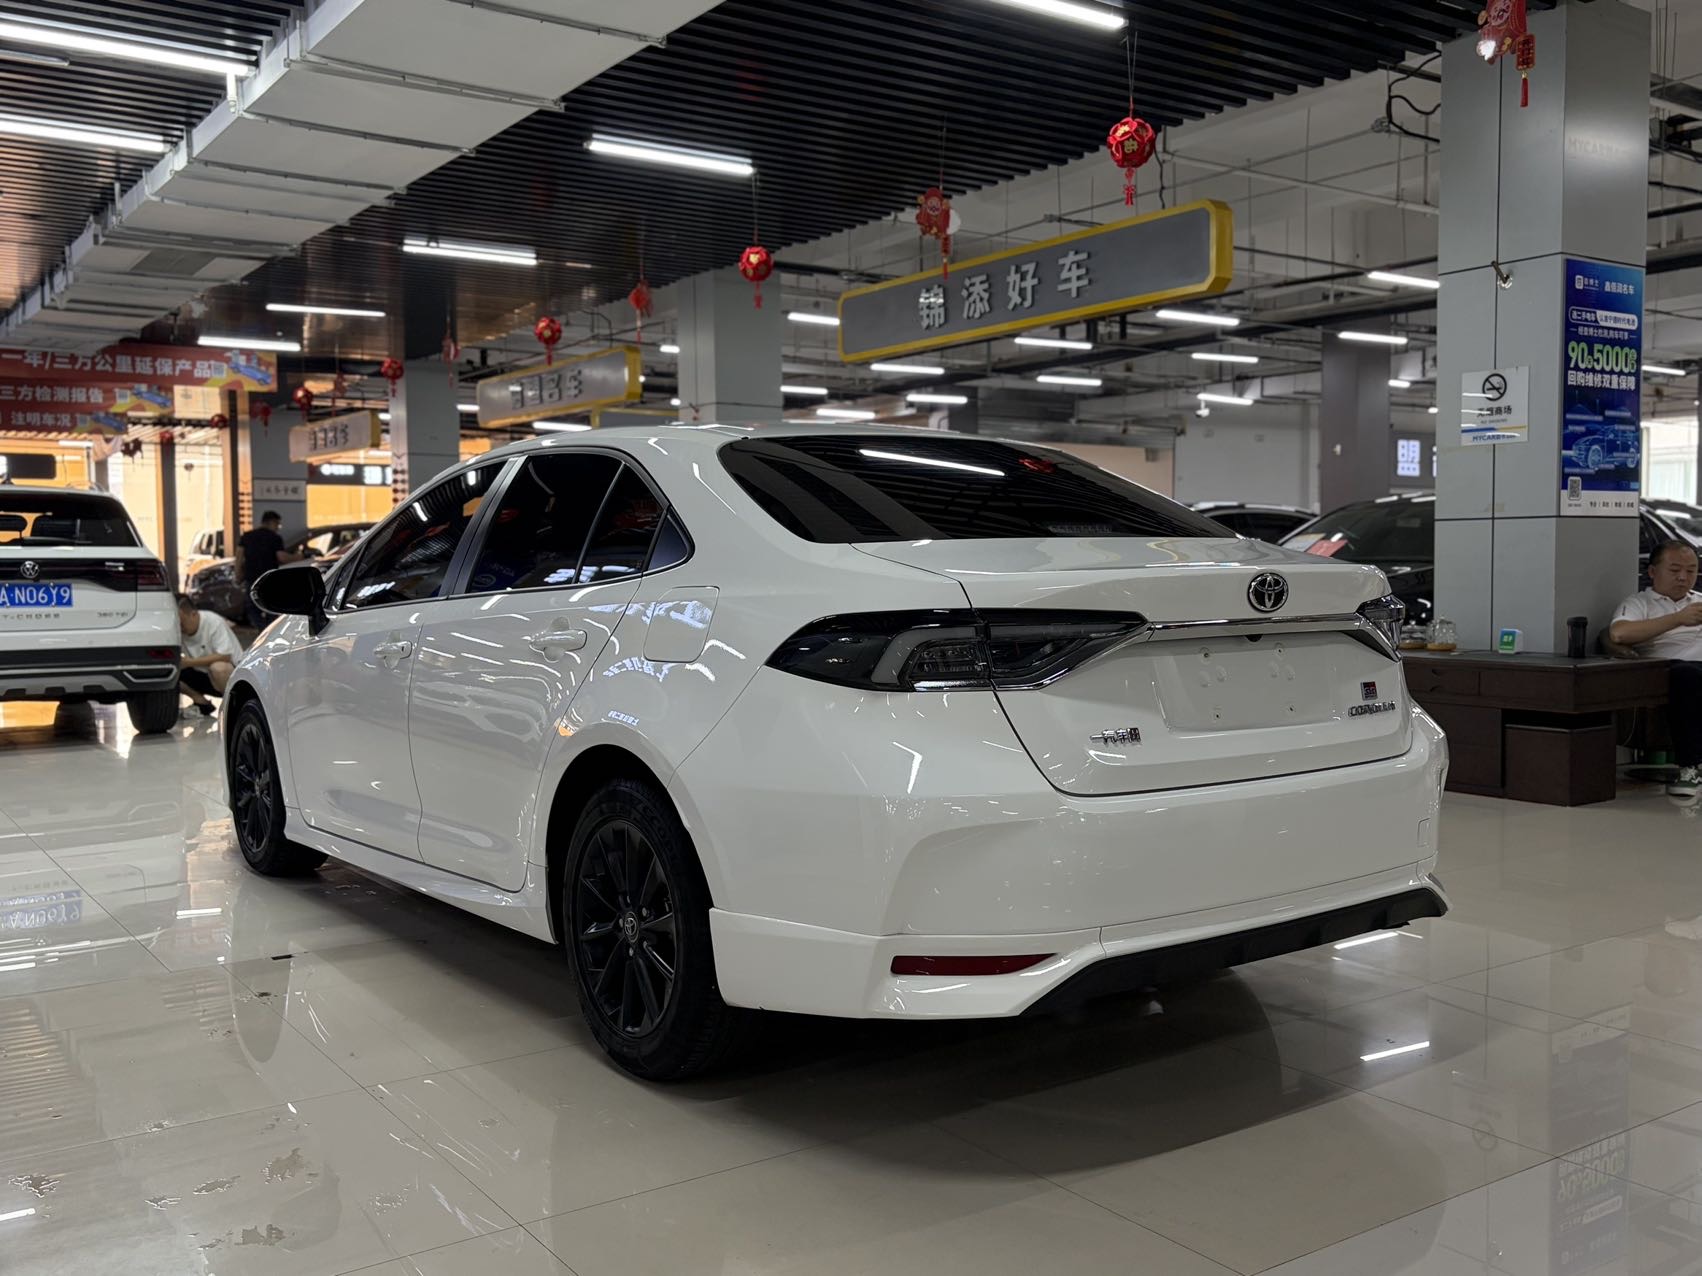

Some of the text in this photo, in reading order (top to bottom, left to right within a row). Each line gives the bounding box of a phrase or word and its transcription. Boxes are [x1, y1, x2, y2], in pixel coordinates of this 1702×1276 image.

[918, 250, 1090, 330] 锦添好车
[1567, 370, 1636, 391] 回购维修双重保障
